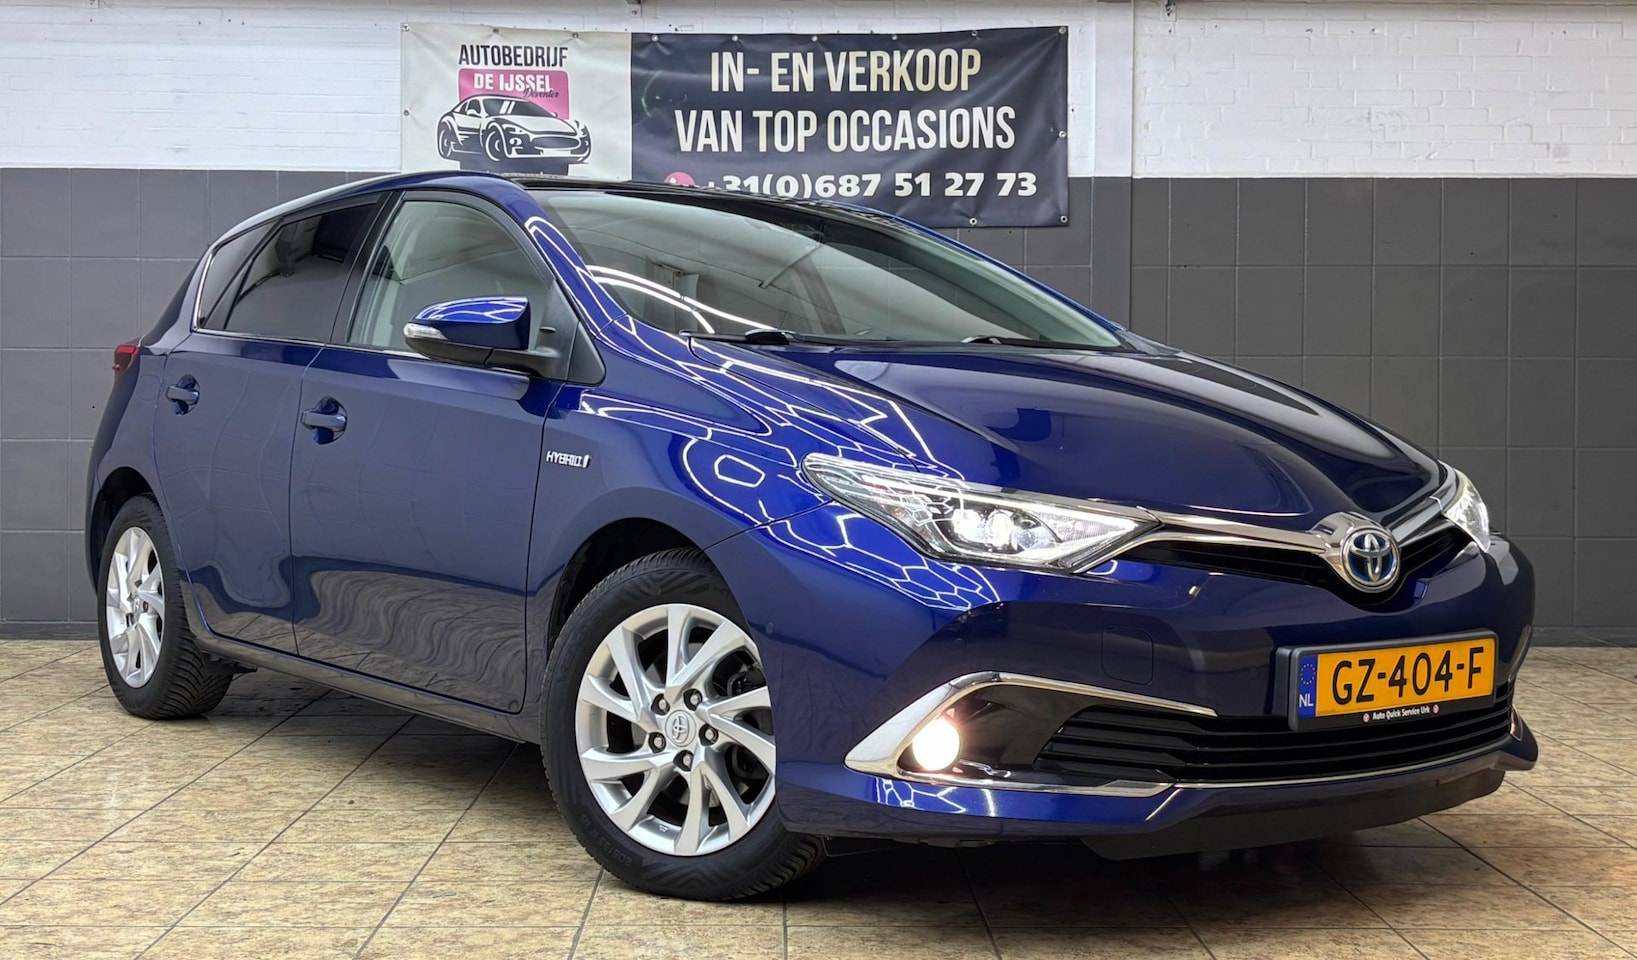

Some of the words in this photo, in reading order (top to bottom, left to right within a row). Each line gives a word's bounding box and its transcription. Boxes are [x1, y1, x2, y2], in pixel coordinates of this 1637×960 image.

[459, 44, 568, 67] AUTOBEDRIJF
[711, 51, 760, 92] IN-
[771, 52, 815, 92] EN
[824, 48, 981, 92] VERKOOP
[473, 73, 494, 90] DE
[499, 74, 553, 93] IJSSEL
[675, 110, 742, 152] VAN
[752, 110, 817, 153] TOP
[827, 106, 1016, 152] OCCASIONS
[895, 172, 931, 197] 51
[944, 172, 985, 197] 27
[997, 172, 1037, 197] 73
[546, 450, 583, 467] HYBRID
[1332, 646, 1484, 705] GZ-404-F
[1299, 693, 1314, 707] NL
[1372, 711, 1385, 720] Auto
[1386, 709, 1401, 720] Quick
[1401, 708, 1420, 717] Service
[1420, 705, 1431, 714] Urk
